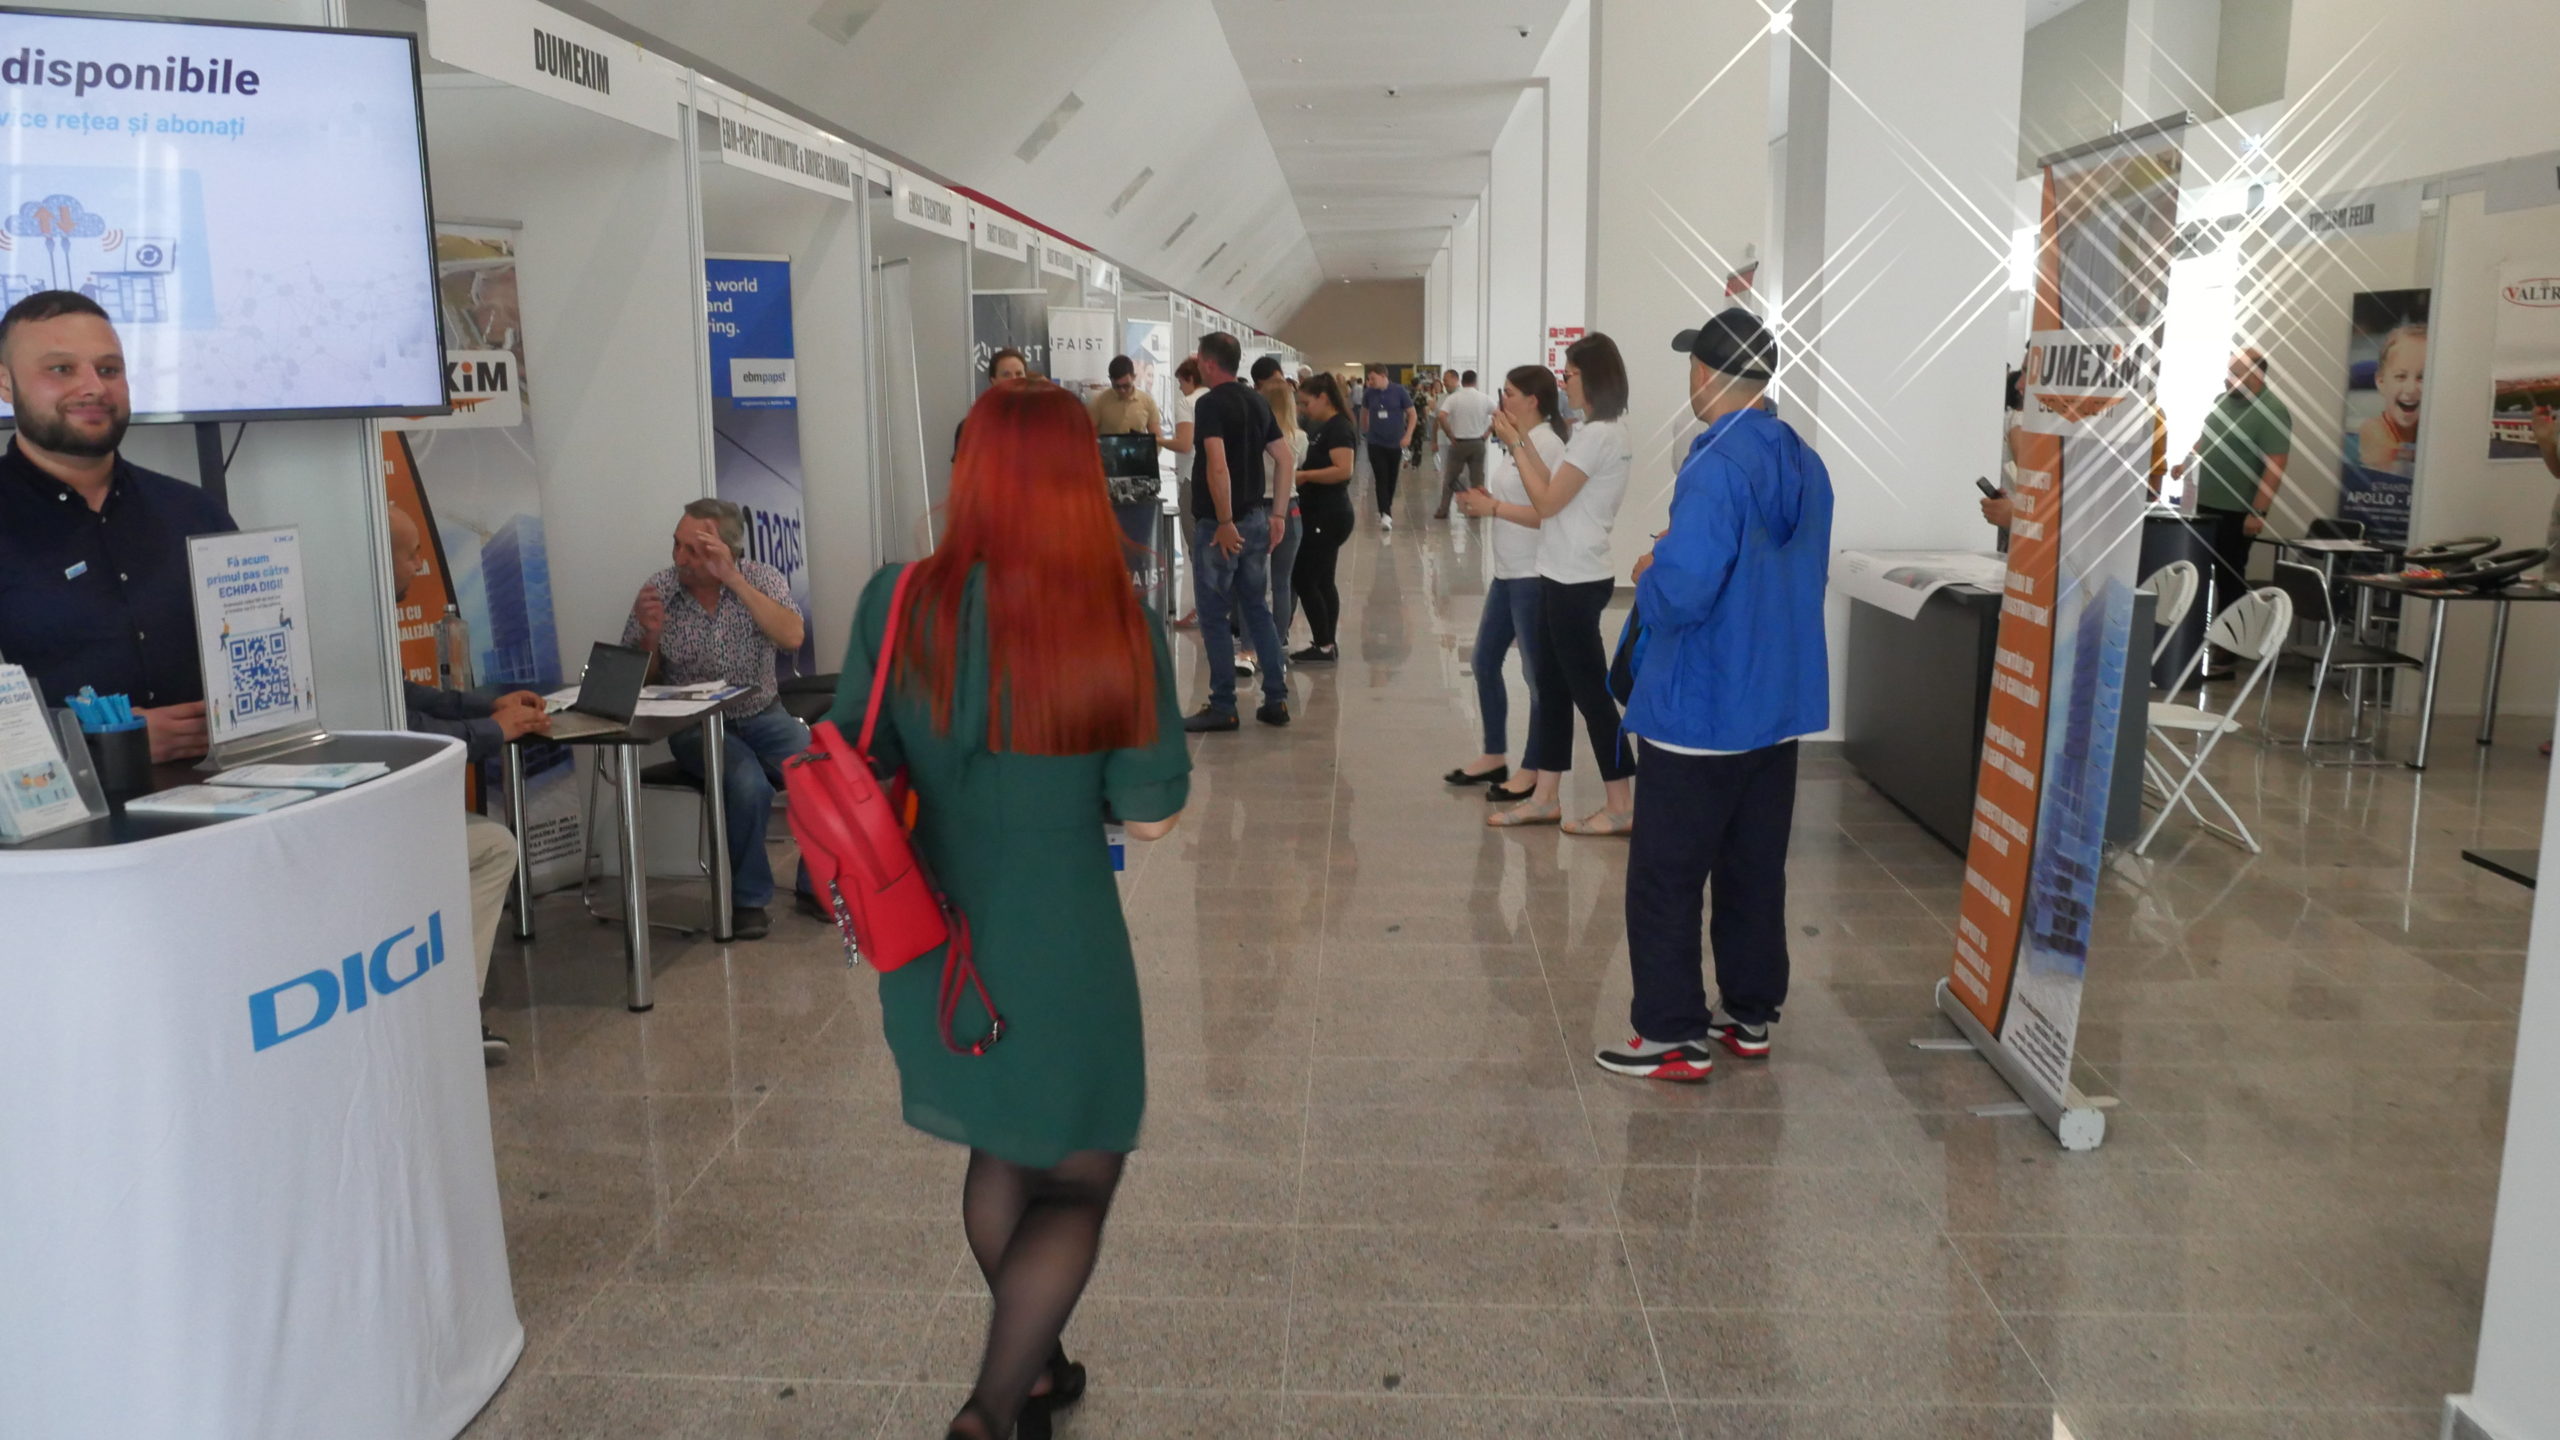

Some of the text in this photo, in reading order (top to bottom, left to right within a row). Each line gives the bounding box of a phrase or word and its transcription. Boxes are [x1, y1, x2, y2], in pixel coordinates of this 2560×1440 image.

[533, 28, 611, 95] DUMEXIM
[1, 48, 260, 97] disponibile
[56, 112, 119, 135] rețea
[128, 113, 149, 137] și
[155, 114, 246, 142] abonați
[721, 116, 760, 159] EBM-PAPST
[2348, 203, 2376, 228] FELIX
[715, 276, 758, 293] world
[1057, 337, 1103, 351] FAIST
[743, 372, 786, 384] ebmpapst
[2346, 491, 2395, 505] APOLLO
[241, 554, 270, 566] acum
[206, 569, 241, 588] primul
[242, 569, 261, 583] pas
[1132, 567, 1165, 586] AIST
[218, 583, 258, 598] ECHIPA
[406, 605, 422, 620] CU
[409, 666, 432, 682] PVC
[248, 909, 445, 1053] DIGI
